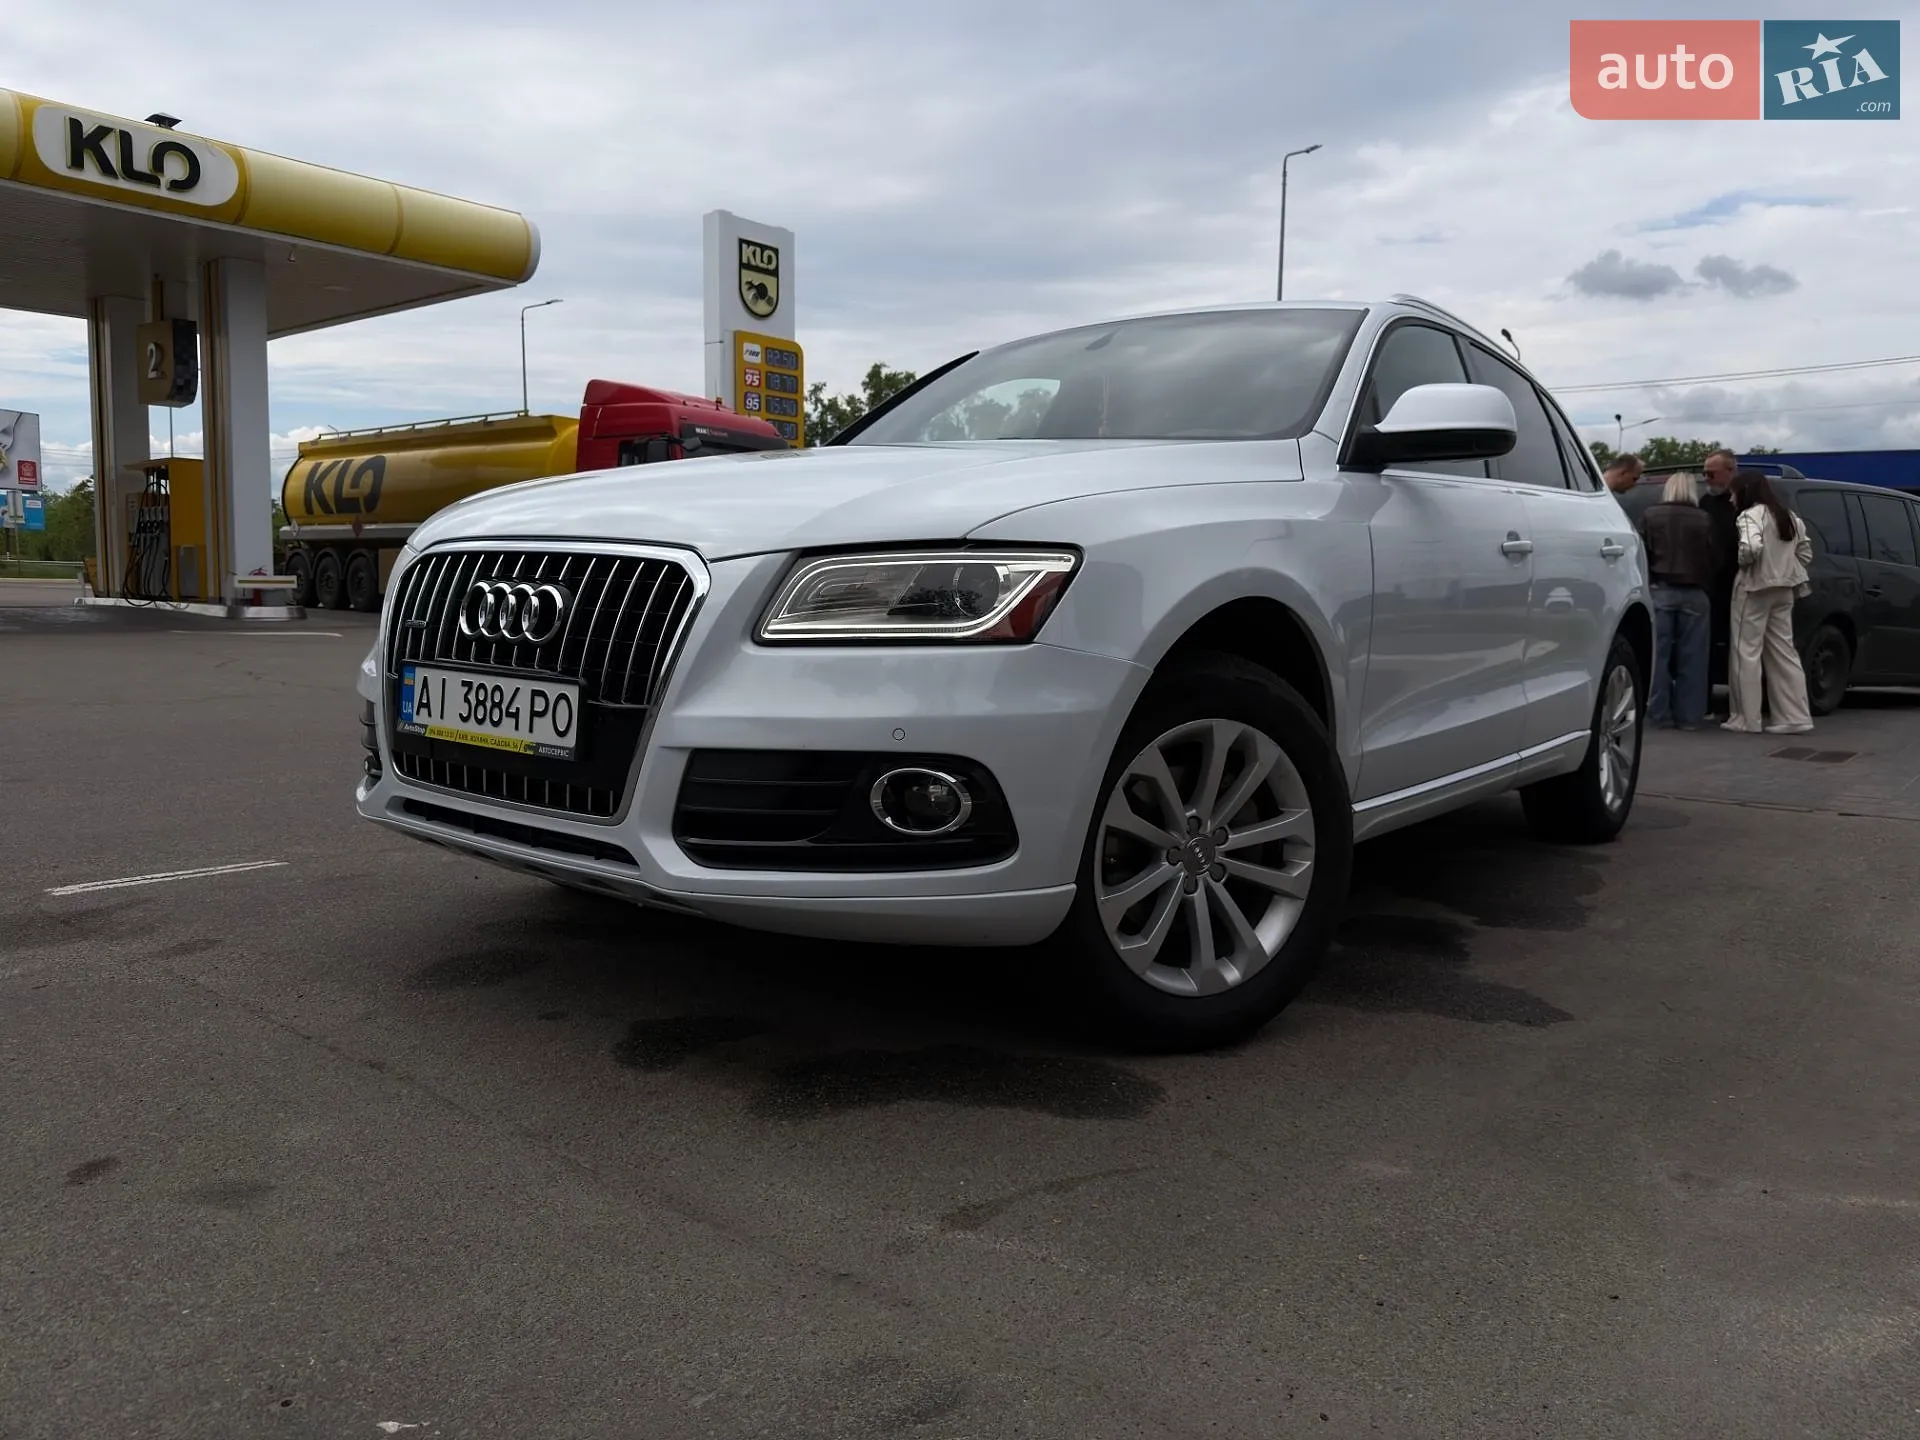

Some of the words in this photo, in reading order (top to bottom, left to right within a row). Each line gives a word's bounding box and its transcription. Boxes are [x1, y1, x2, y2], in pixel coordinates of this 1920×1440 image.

[65, 116, 201, 191] KLO
[741, 242, 778, 271] KLO
[146, 341, 164, 379] 2
[745, 374, 760, 386] 95
[745, 397, 760, 410] 95
[304, 455, 387, 515] KLO
[402, 701, 413, 714] UA
[415, 675, 447, 720] AI
[458, 679, 522, 731] 3884
[528, 688, 573, 738] PO
